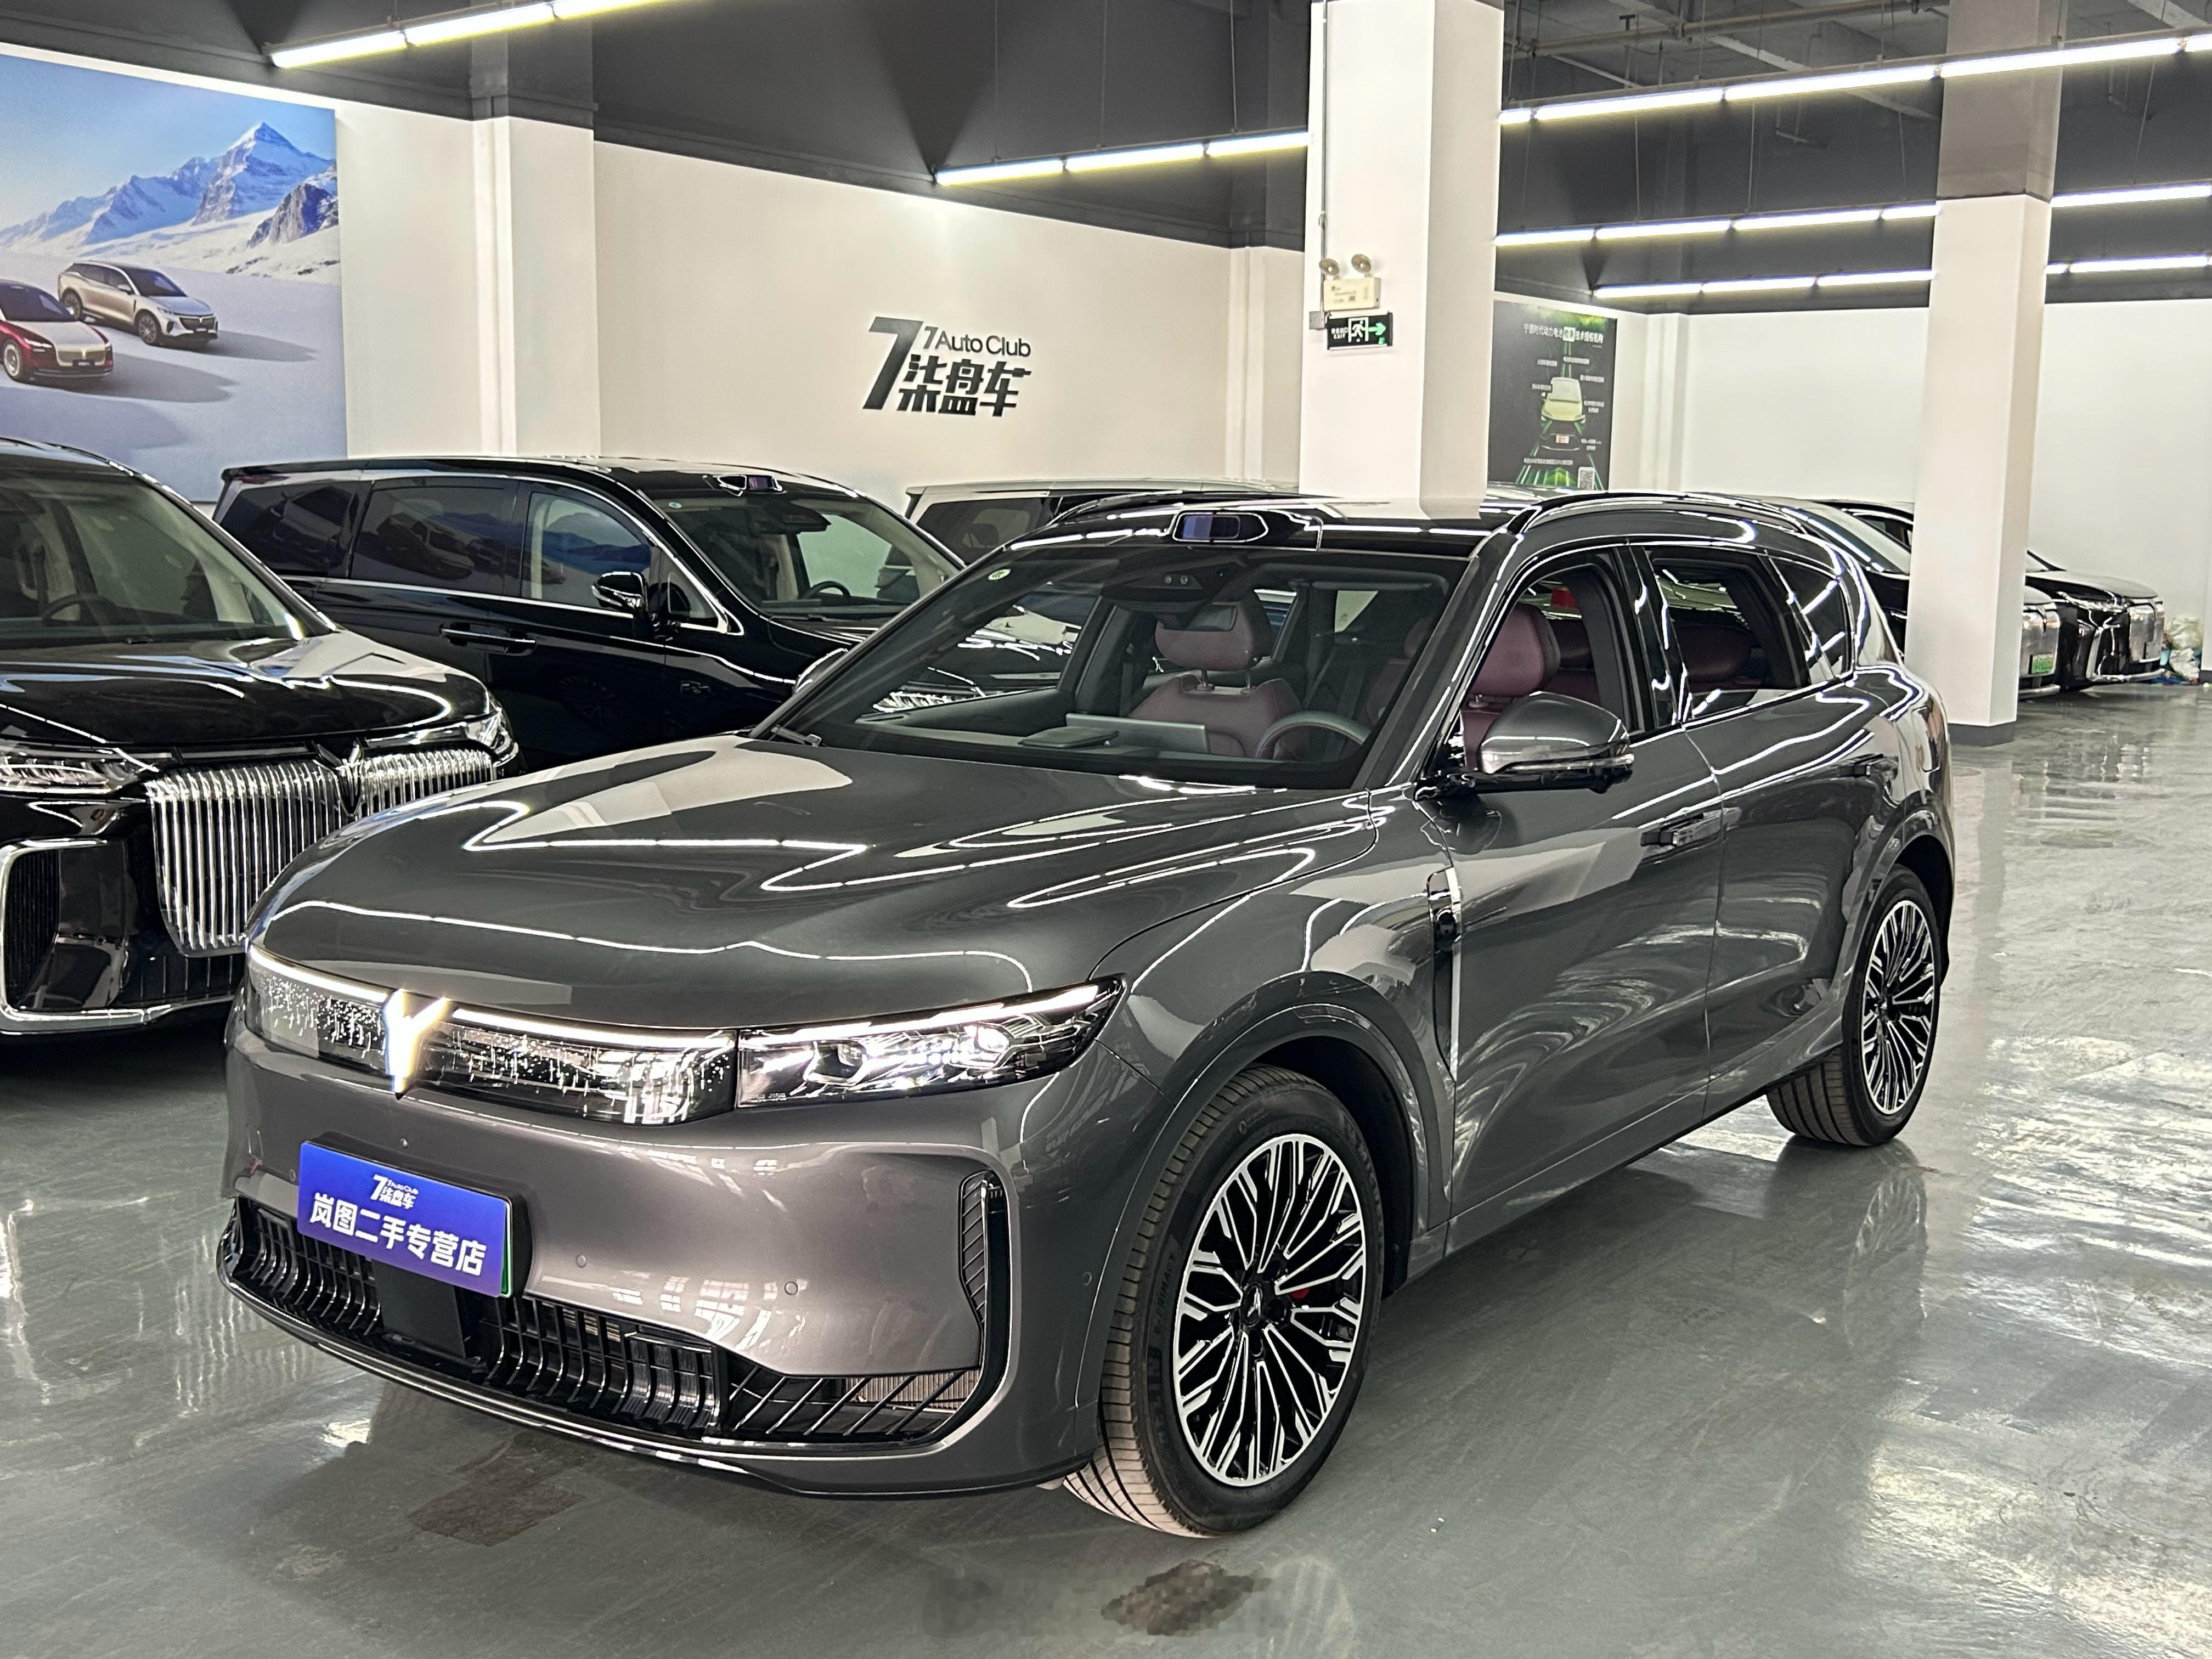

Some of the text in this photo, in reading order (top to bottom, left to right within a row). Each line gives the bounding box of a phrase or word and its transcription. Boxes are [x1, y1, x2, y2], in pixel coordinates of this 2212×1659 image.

[987, 335, 1032, 357] Club
[896, 354, 1032, 417] 柒盘车
[309, 1192, 487, 1277] 岚图二手专营店
